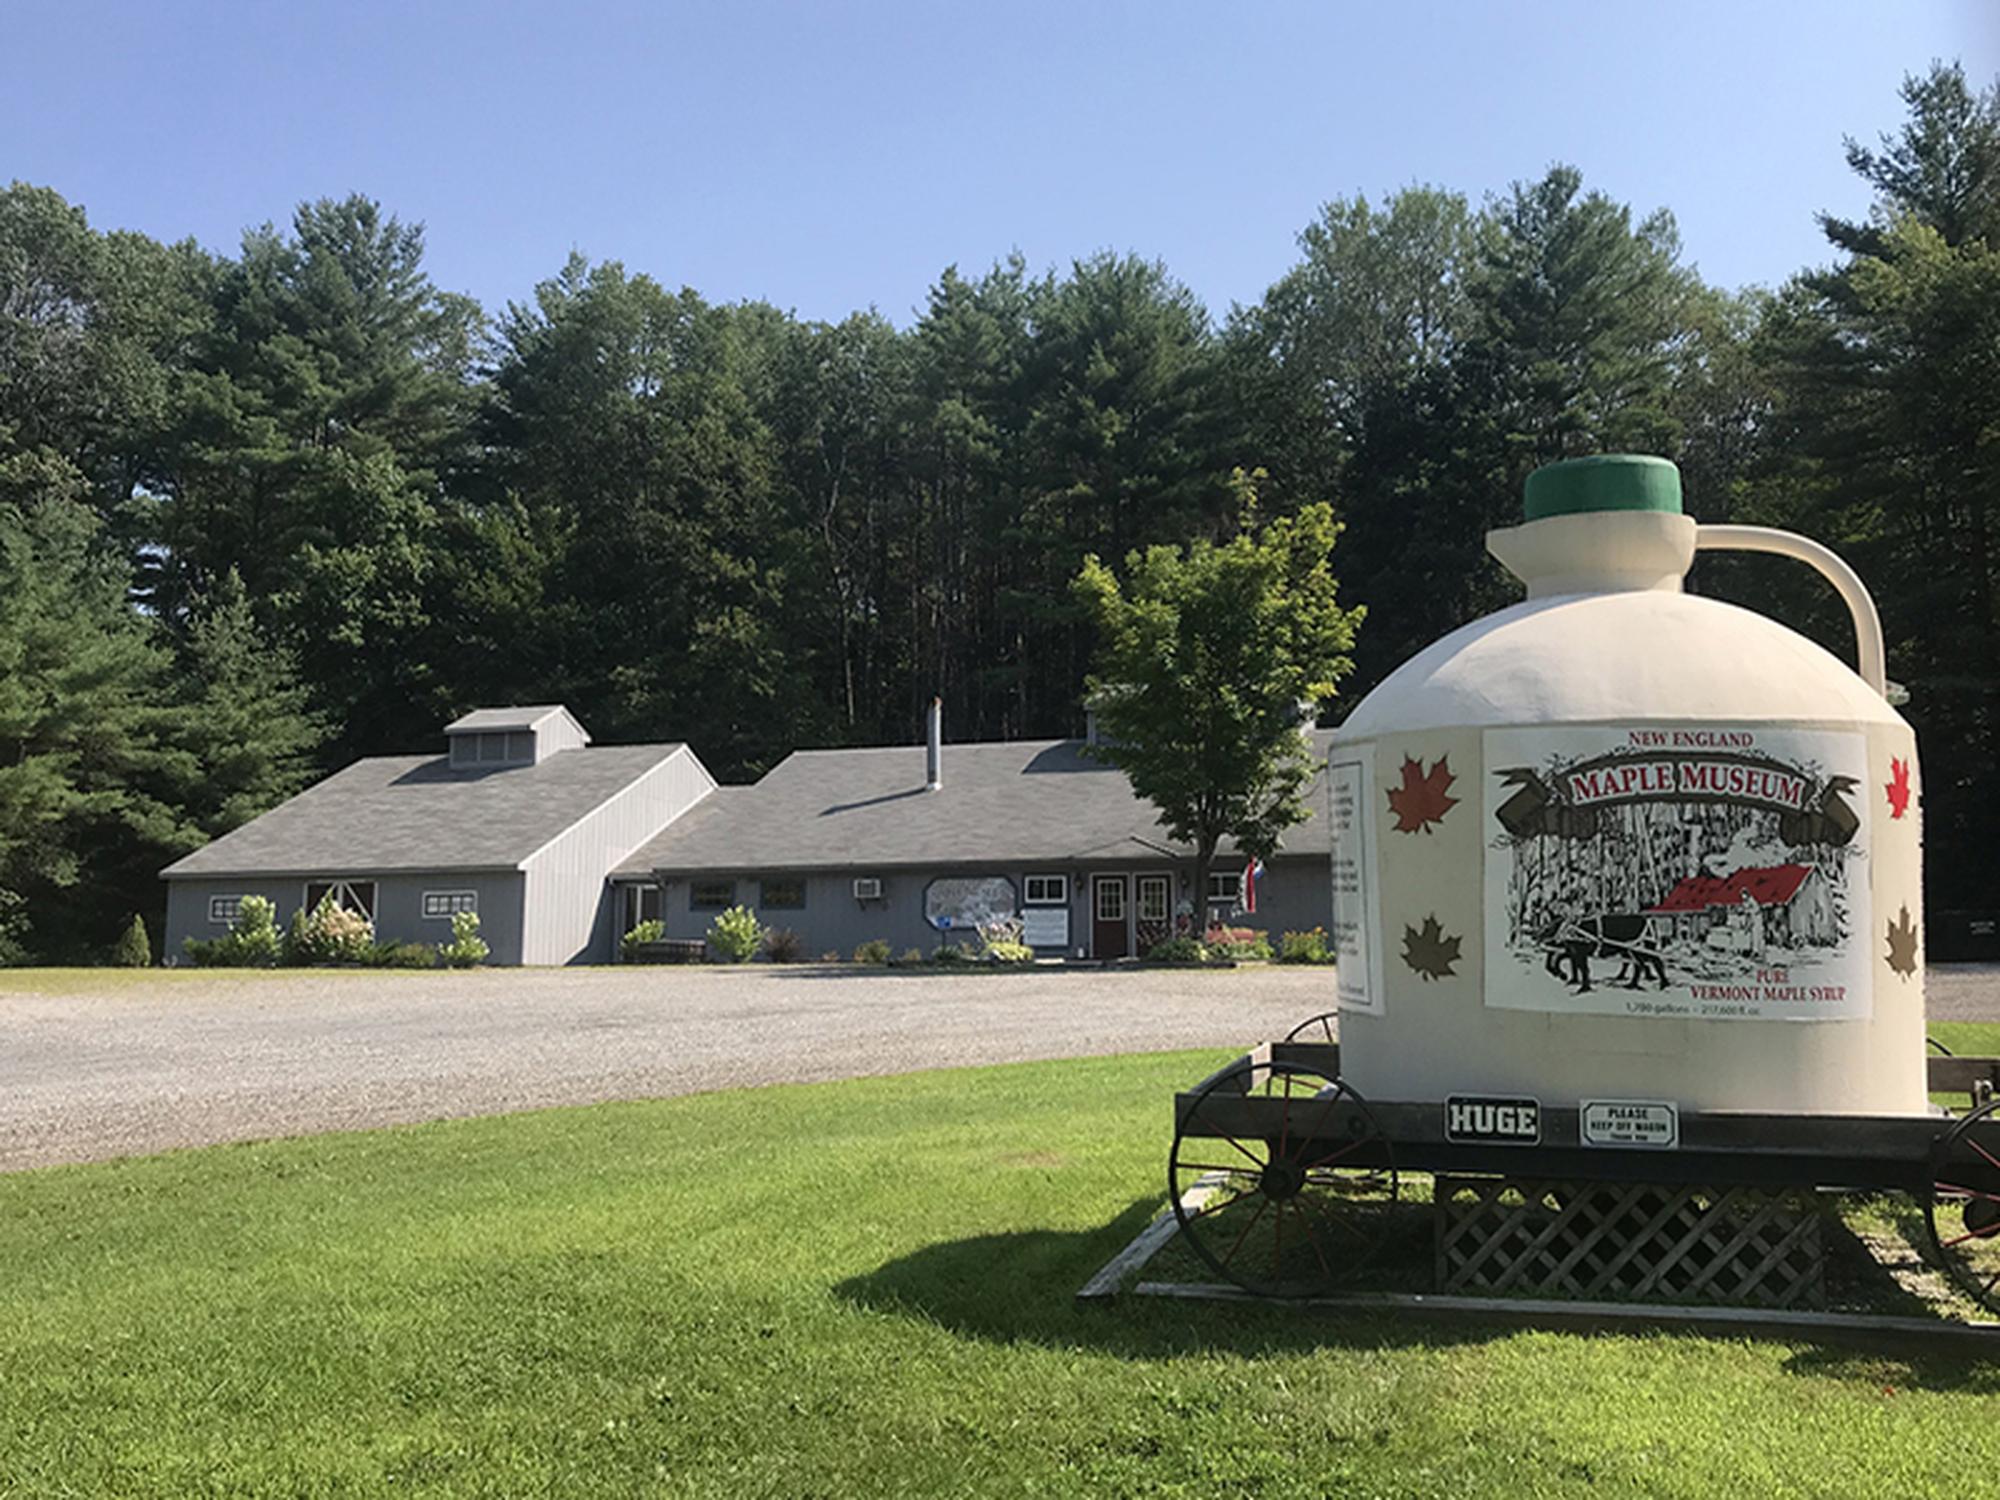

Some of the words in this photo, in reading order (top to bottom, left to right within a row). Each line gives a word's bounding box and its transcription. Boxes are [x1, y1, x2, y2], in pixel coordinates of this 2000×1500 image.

[1629, 731, 1667, 747] NEW
[1673, 731, 1754, 748] ENGLAND
[1572, 764, 1673, 801] MAPLE
[1681, 764, 1803, 806] MUSEUM
[1756, 969, 1790, 984] PURE
[1690, 985, 1760, 1001] VERMONT
[1764, 986, 1806, 1001] MAPLE
[1808, 986, 1847, 1001] SYRUP
[1450, 1104, 1537, 1136] HUGE
[1608, 1107, 1648, 1120] PLEASE
[1591, 1121, 1613, 1131] KEEP
[1616, 1121, 1632, 1131] OFF
